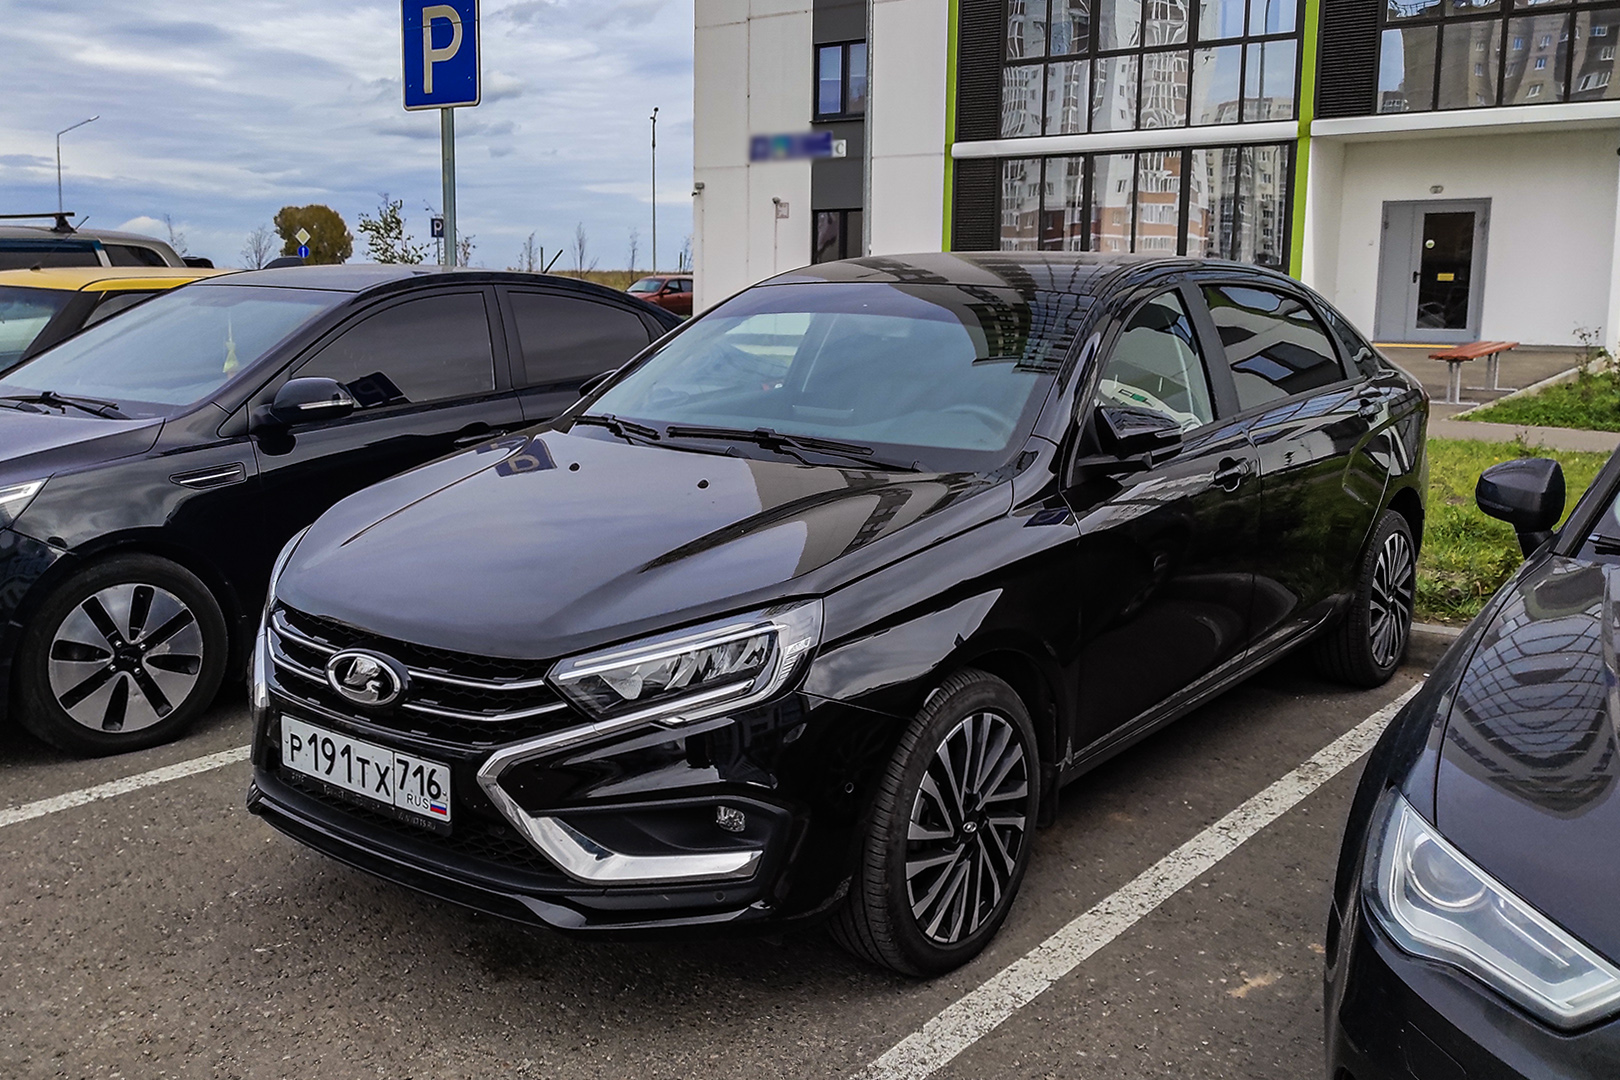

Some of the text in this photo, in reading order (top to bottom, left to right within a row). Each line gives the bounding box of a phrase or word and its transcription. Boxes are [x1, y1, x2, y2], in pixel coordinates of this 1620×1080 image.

[422, 4, 463, 95] P
[433, 220, 443, 236] P
[396, 757, 442, 800] 716
[406, 793, 429, 810] RUS
